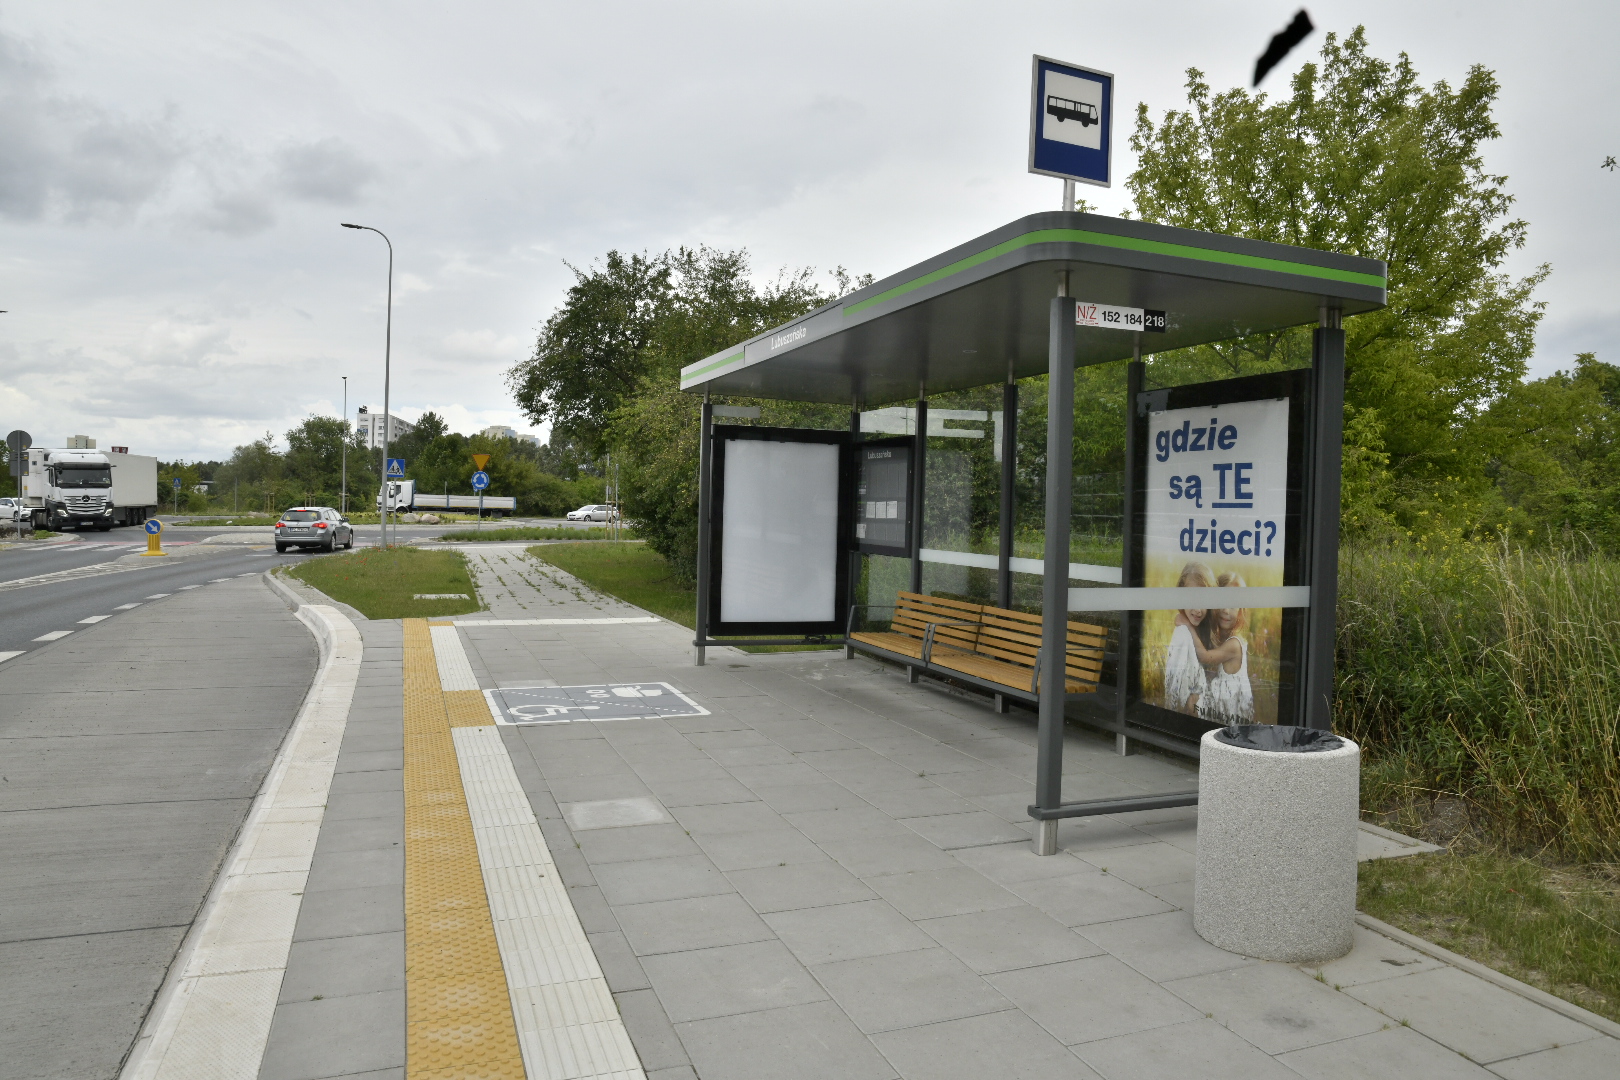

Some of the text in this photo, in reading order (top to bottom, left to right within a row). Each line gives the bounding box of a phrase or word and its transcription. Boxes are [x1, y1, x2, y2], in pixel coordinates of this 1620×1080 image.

[1077, 304, 1097, 319] N/Ż
[1101, 310, 1120, 323] 152
[1124, 313, 1142, 325] 184
[1145, 315, 1164, 327] 218
[1155, 418, 1238, 462] gdzie
[1169, 463, 1253, 508] są TE
[1179, 519, 1277, 558] dzieci?
